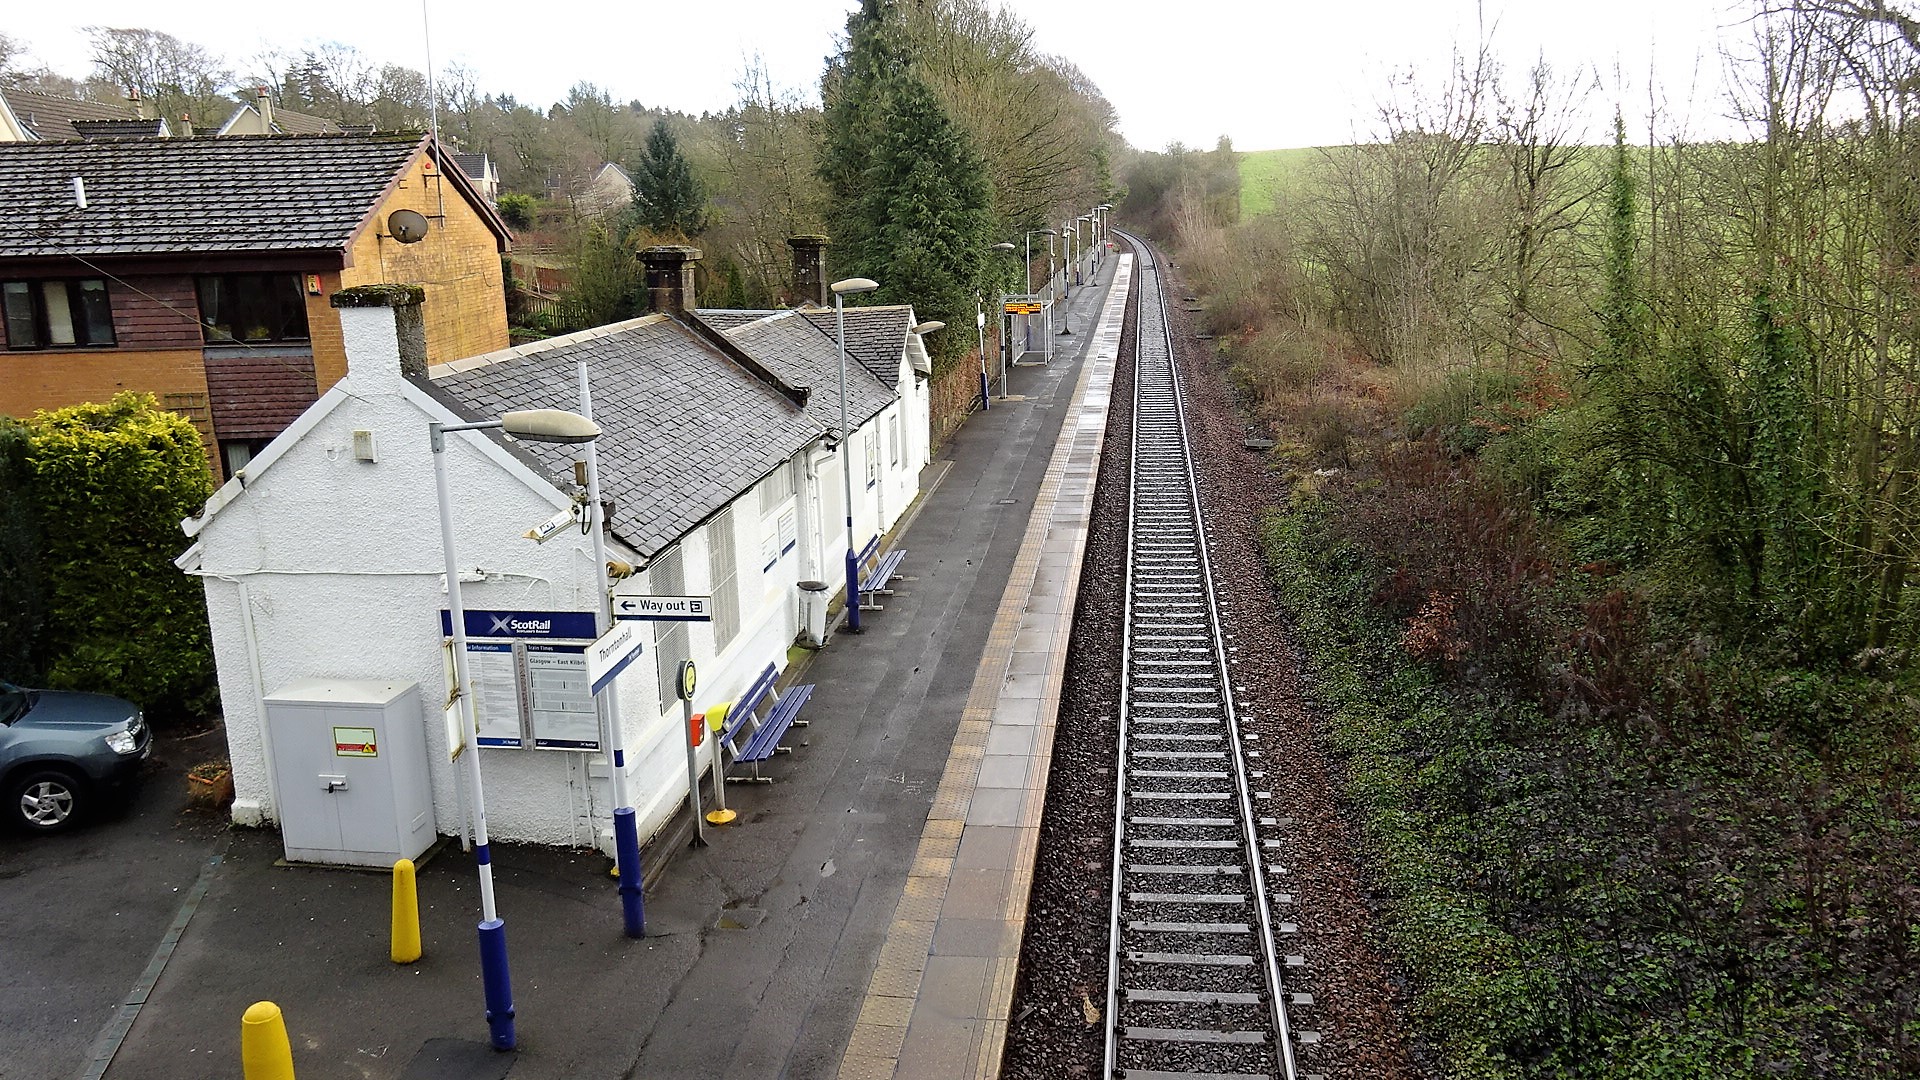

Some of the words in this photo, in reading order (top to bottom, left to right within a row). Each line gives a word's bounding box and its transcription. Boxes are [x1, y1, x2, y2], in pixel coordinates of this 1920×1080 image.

[640, 600, 663, 613] Way
[666, 601, 686, 611] out
[510, 619, 551, 630] ScotRail
[599, 626, 632, 662] Thorntonhall
